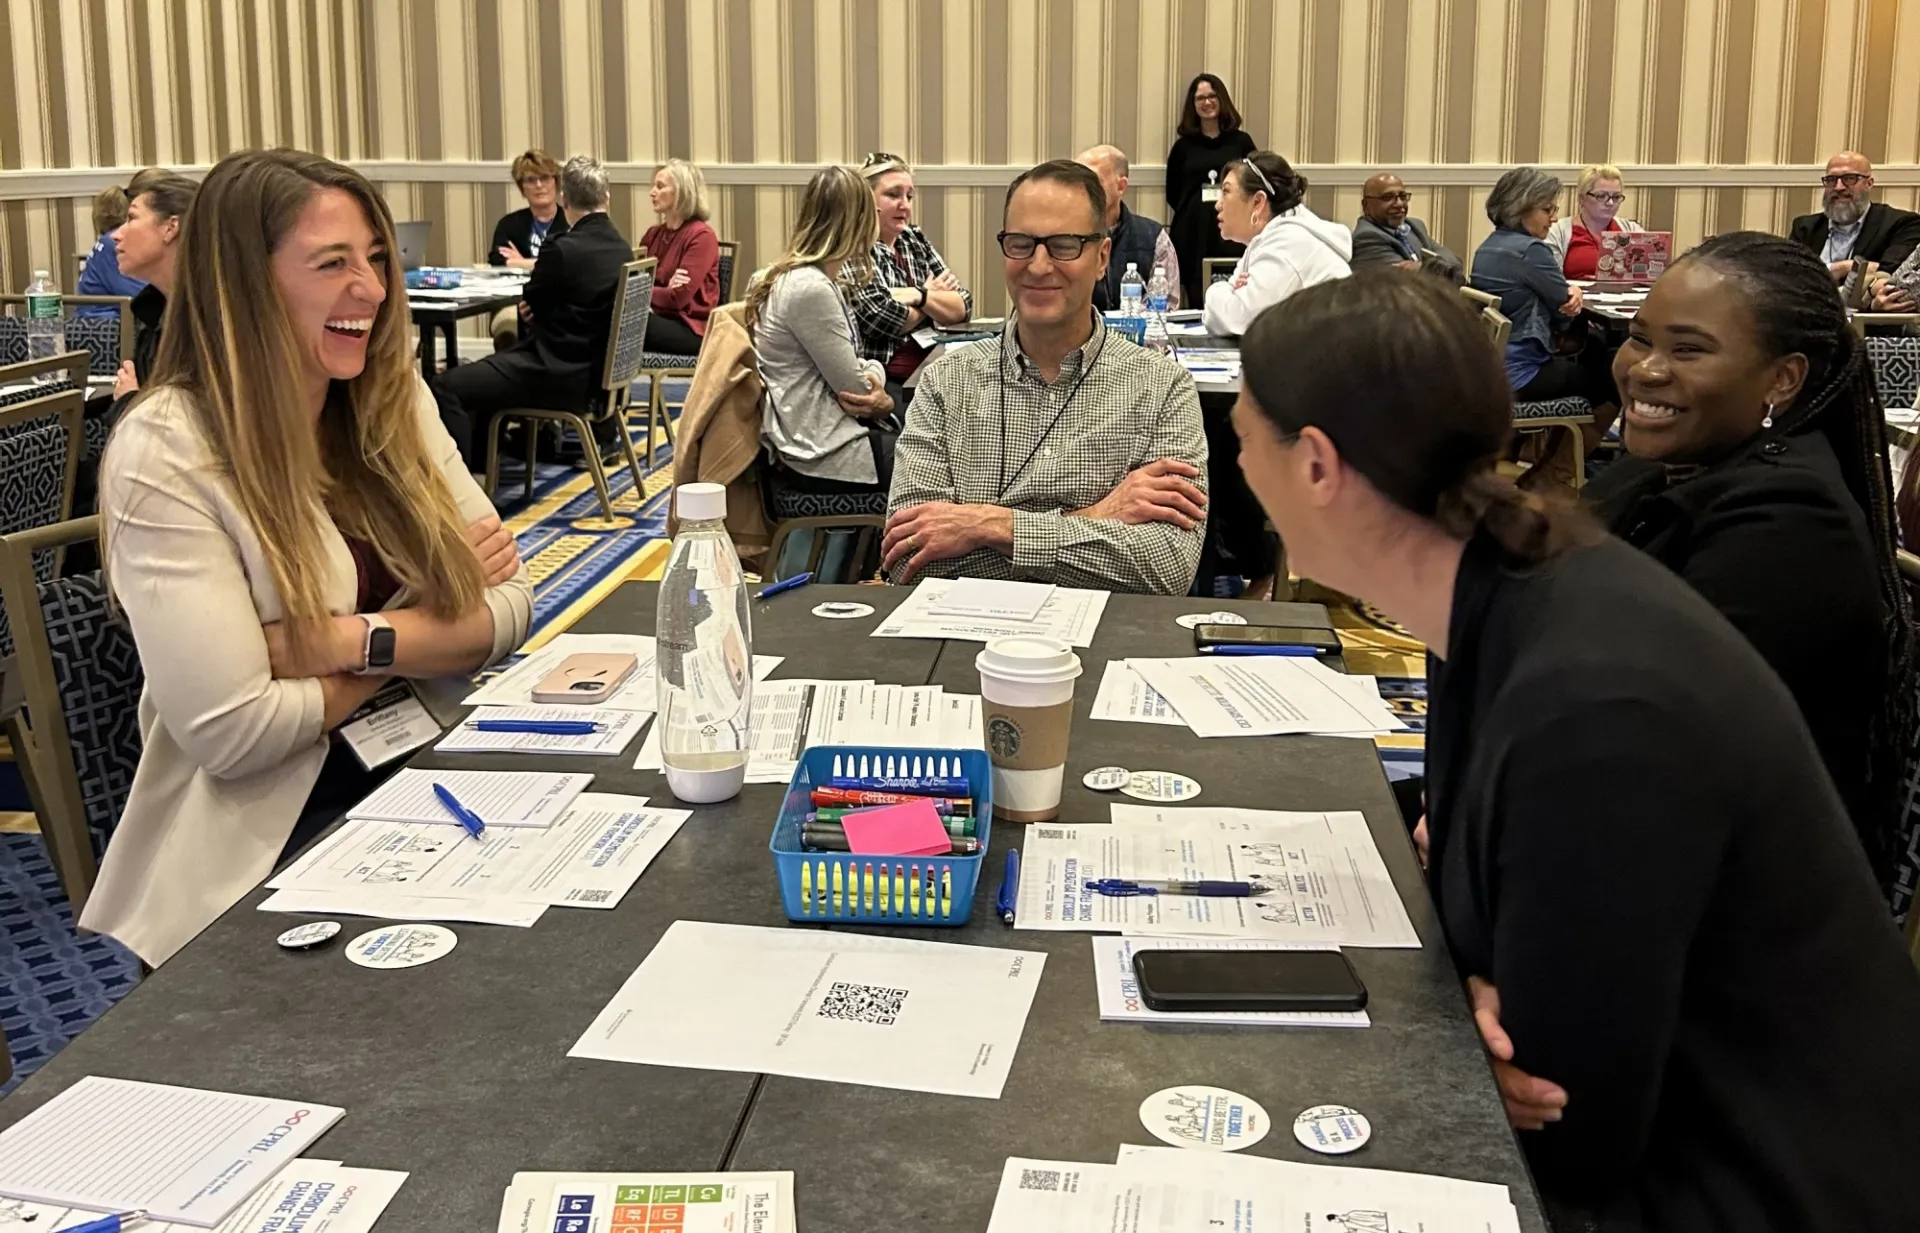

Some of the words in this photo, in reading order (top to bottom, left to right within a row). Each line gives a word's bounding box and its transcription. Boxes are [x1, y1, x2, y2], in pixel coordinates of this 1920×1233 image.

[874, 776, 919, 790] Sharpie
[362, 932, 393, 956] TOGETHER
[1121, 978, 1138, 998] CPRL
[1227, 1104, 1243, 1138] TOGETHER
[1335, 1117, 1355, 1140] PROCESS
[248, 1125, 292, 1153] CPRL
[1211, 1119, 1225, 1146] LEARNING
[1310, 1124, 1328, 1145] CHANGE
[274, 1181, 312, 1214] CHANGE
[624, 1188, 645, 1200] Eq
[664, 1189, 681, 1199] TL
[700, 1187, 716, 1200] Cu
[753, 1193, 769, 1208] The
[281, 1182, 335, 1233] CURRICULUM
[327, 1197, 349, 1215] CPRL
[571, 1199, 588, 1210] Le
[625, 1208, 642, 1220] RF
[662, 1208, 678, 1220] LD
[566, 1219, 584, 1232] Re
[753, 1211, 769, 1233] Elem
